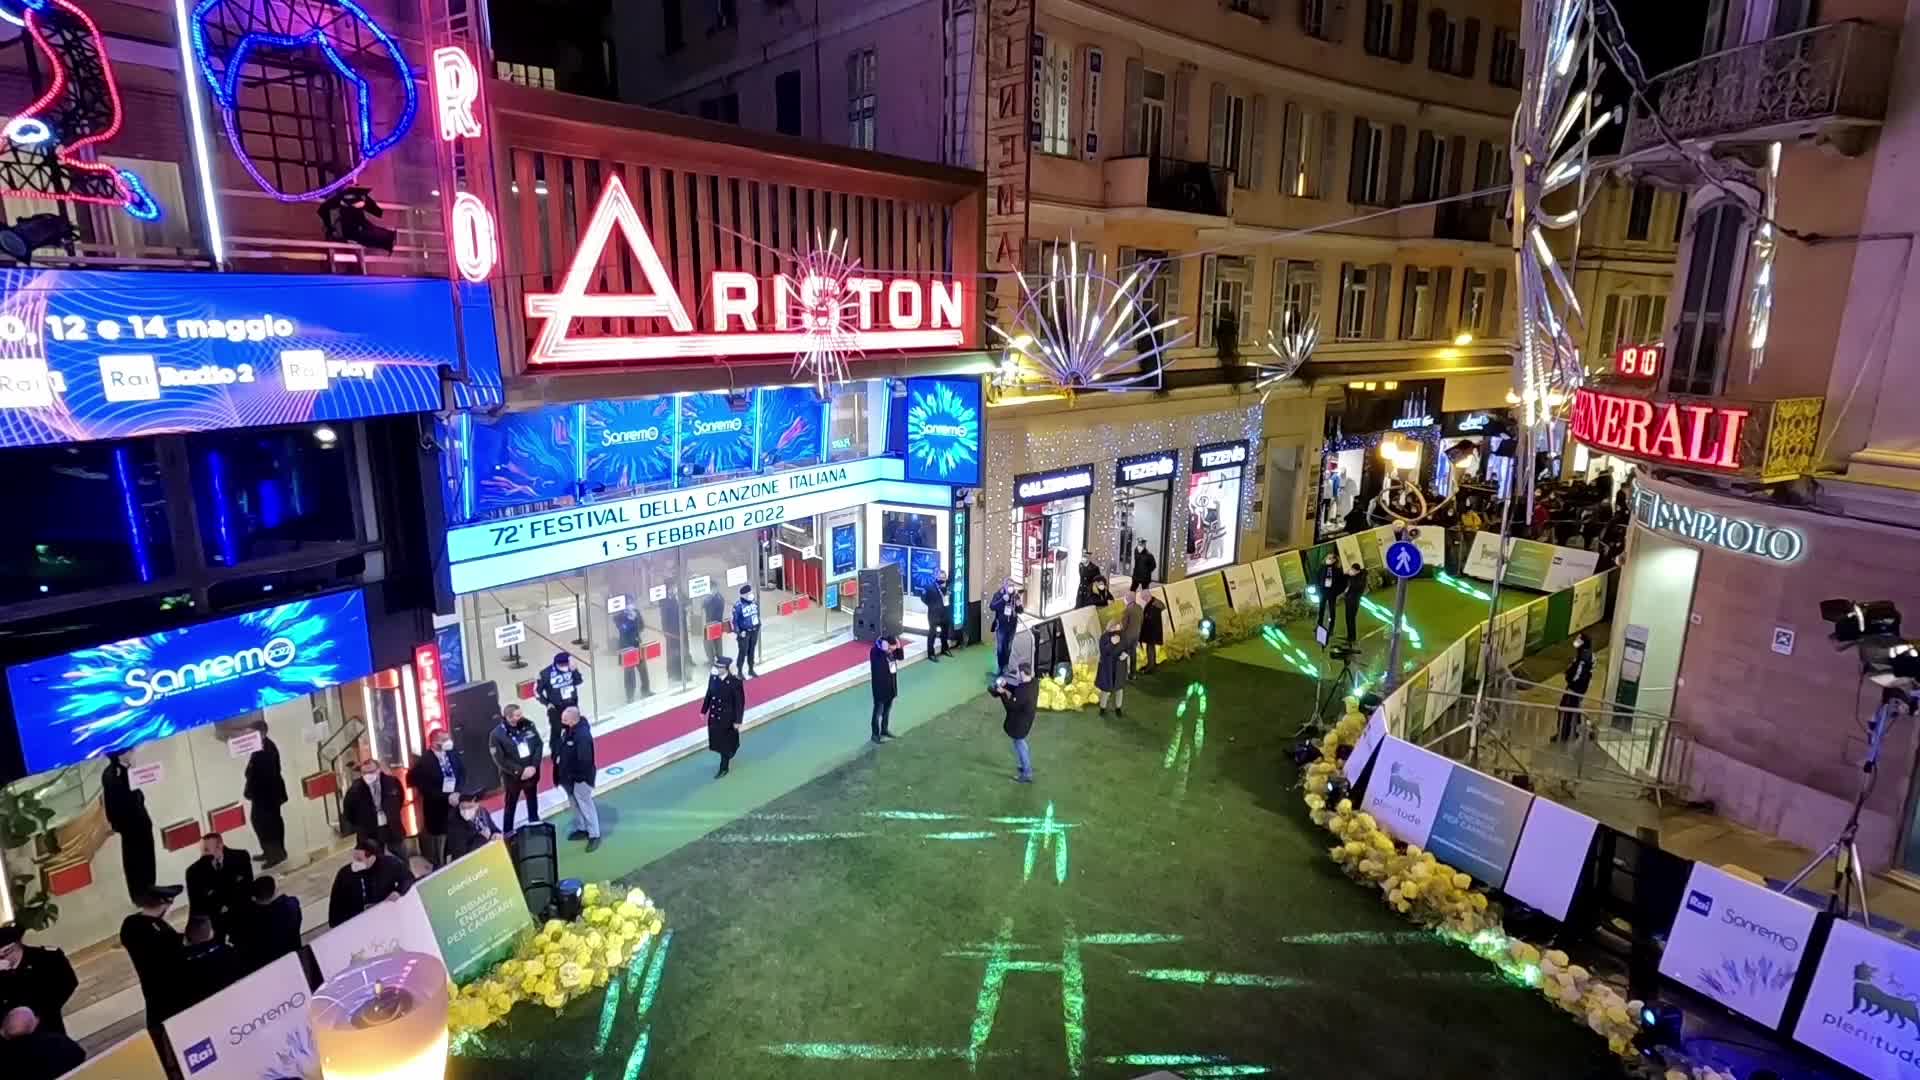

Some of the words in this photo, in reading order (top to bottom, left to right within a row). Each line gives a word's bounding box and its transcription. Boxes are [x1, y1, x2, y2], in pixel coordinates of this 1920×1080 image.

[1033, 59, 1041, 119] MAICO
[46, 314, 89, 341] 12
[96, 319, 121, 340] e
[127, 314, 169, 340] 14
[176, 313, 294, 342] maggio
[110, 371, 152, 387] Rai
[159, 365, 236, 387] Radio
[238, 363, 255, 382] 2
[326, 359, 376, 380] Play
[694, 417, 742, 435] Sanremo
[919, 422, 968, 438] Sanremo
[1393, 418, 1421, 429] LACOSTE
[602, 426, 659, 447] Sanremo
[1199, 446, 1246, 467] TEZENIS
[1122, 457, 1174, 481] TEZENIS
[530, 505, 631, 539] FESTIVAL
[639, 495, 697, 519] DELLA
[706, 480, 780, 507] CANZONE
[789, 467, 848, 489] ITALIANA
[646, 515, 735, 548] FEBBRAIO
[743, 505, 785, 527] 2022
[123, 637, 296, 707] Sanremo
[1721, 908, 1799, 952] Sanremo
[229, 991, 306, 1046] Sanremo
[187, 1043, 215, 1068] Rai
